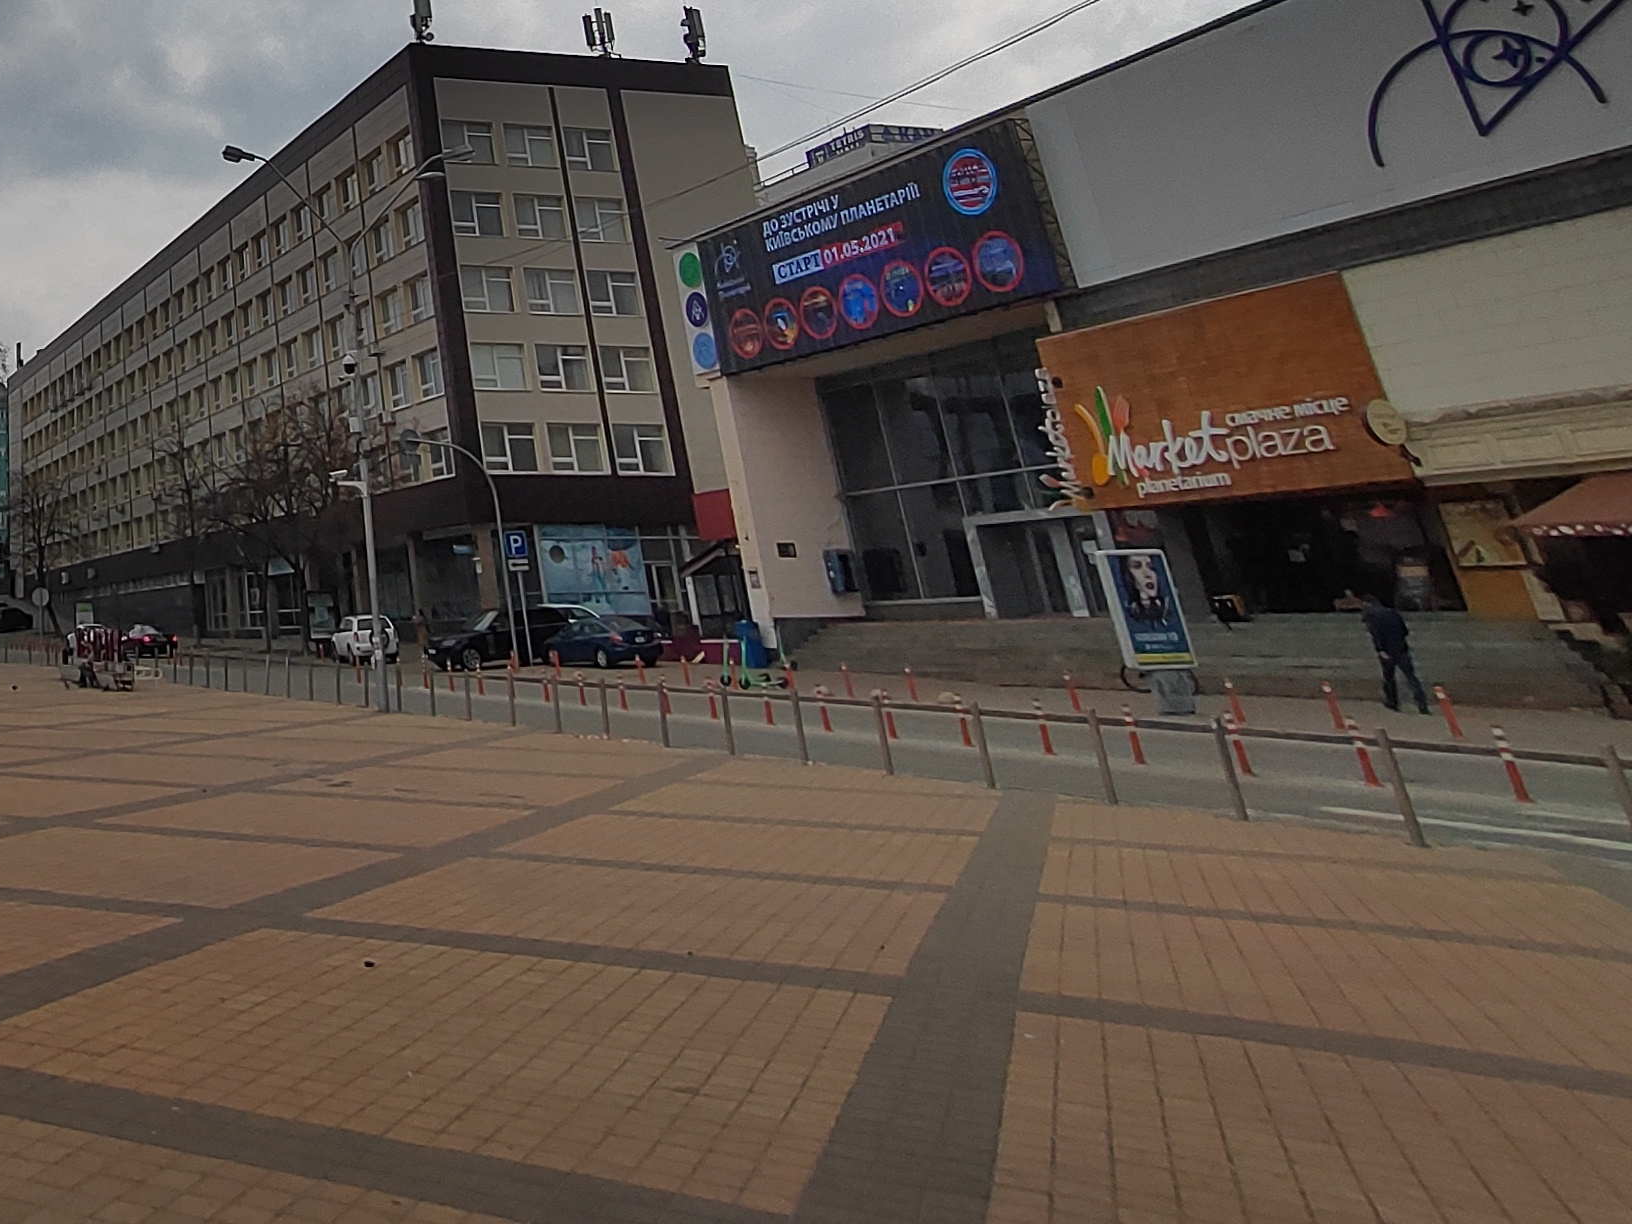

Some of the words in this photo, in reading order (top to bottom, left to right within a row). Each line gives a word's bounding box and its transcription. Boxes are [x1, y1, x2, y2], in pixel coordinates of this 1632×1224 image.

[830, 129, 865, 150] TETRIS
[763, 219, 779, 238] ДО
[780, 198, 830, 229] ЗУСТРІЧІ
[831, 194, 839, 209] У
[765, 213, 838, 252] КИЇВСЬКОМУ
[778, 253, 821, 279] СТАРТ
[823, 227, 896, 264] 01.05.2021
[1225, 405, 1293, 427] смачне
[1293, 396, 1351, 420] місце
[1107, 410, 1231, 478] Market
[1225, 424, 1337, 469] plaza
[1136, 471, 1232, 498] planetarium
[510, 534, 523, 555] P
